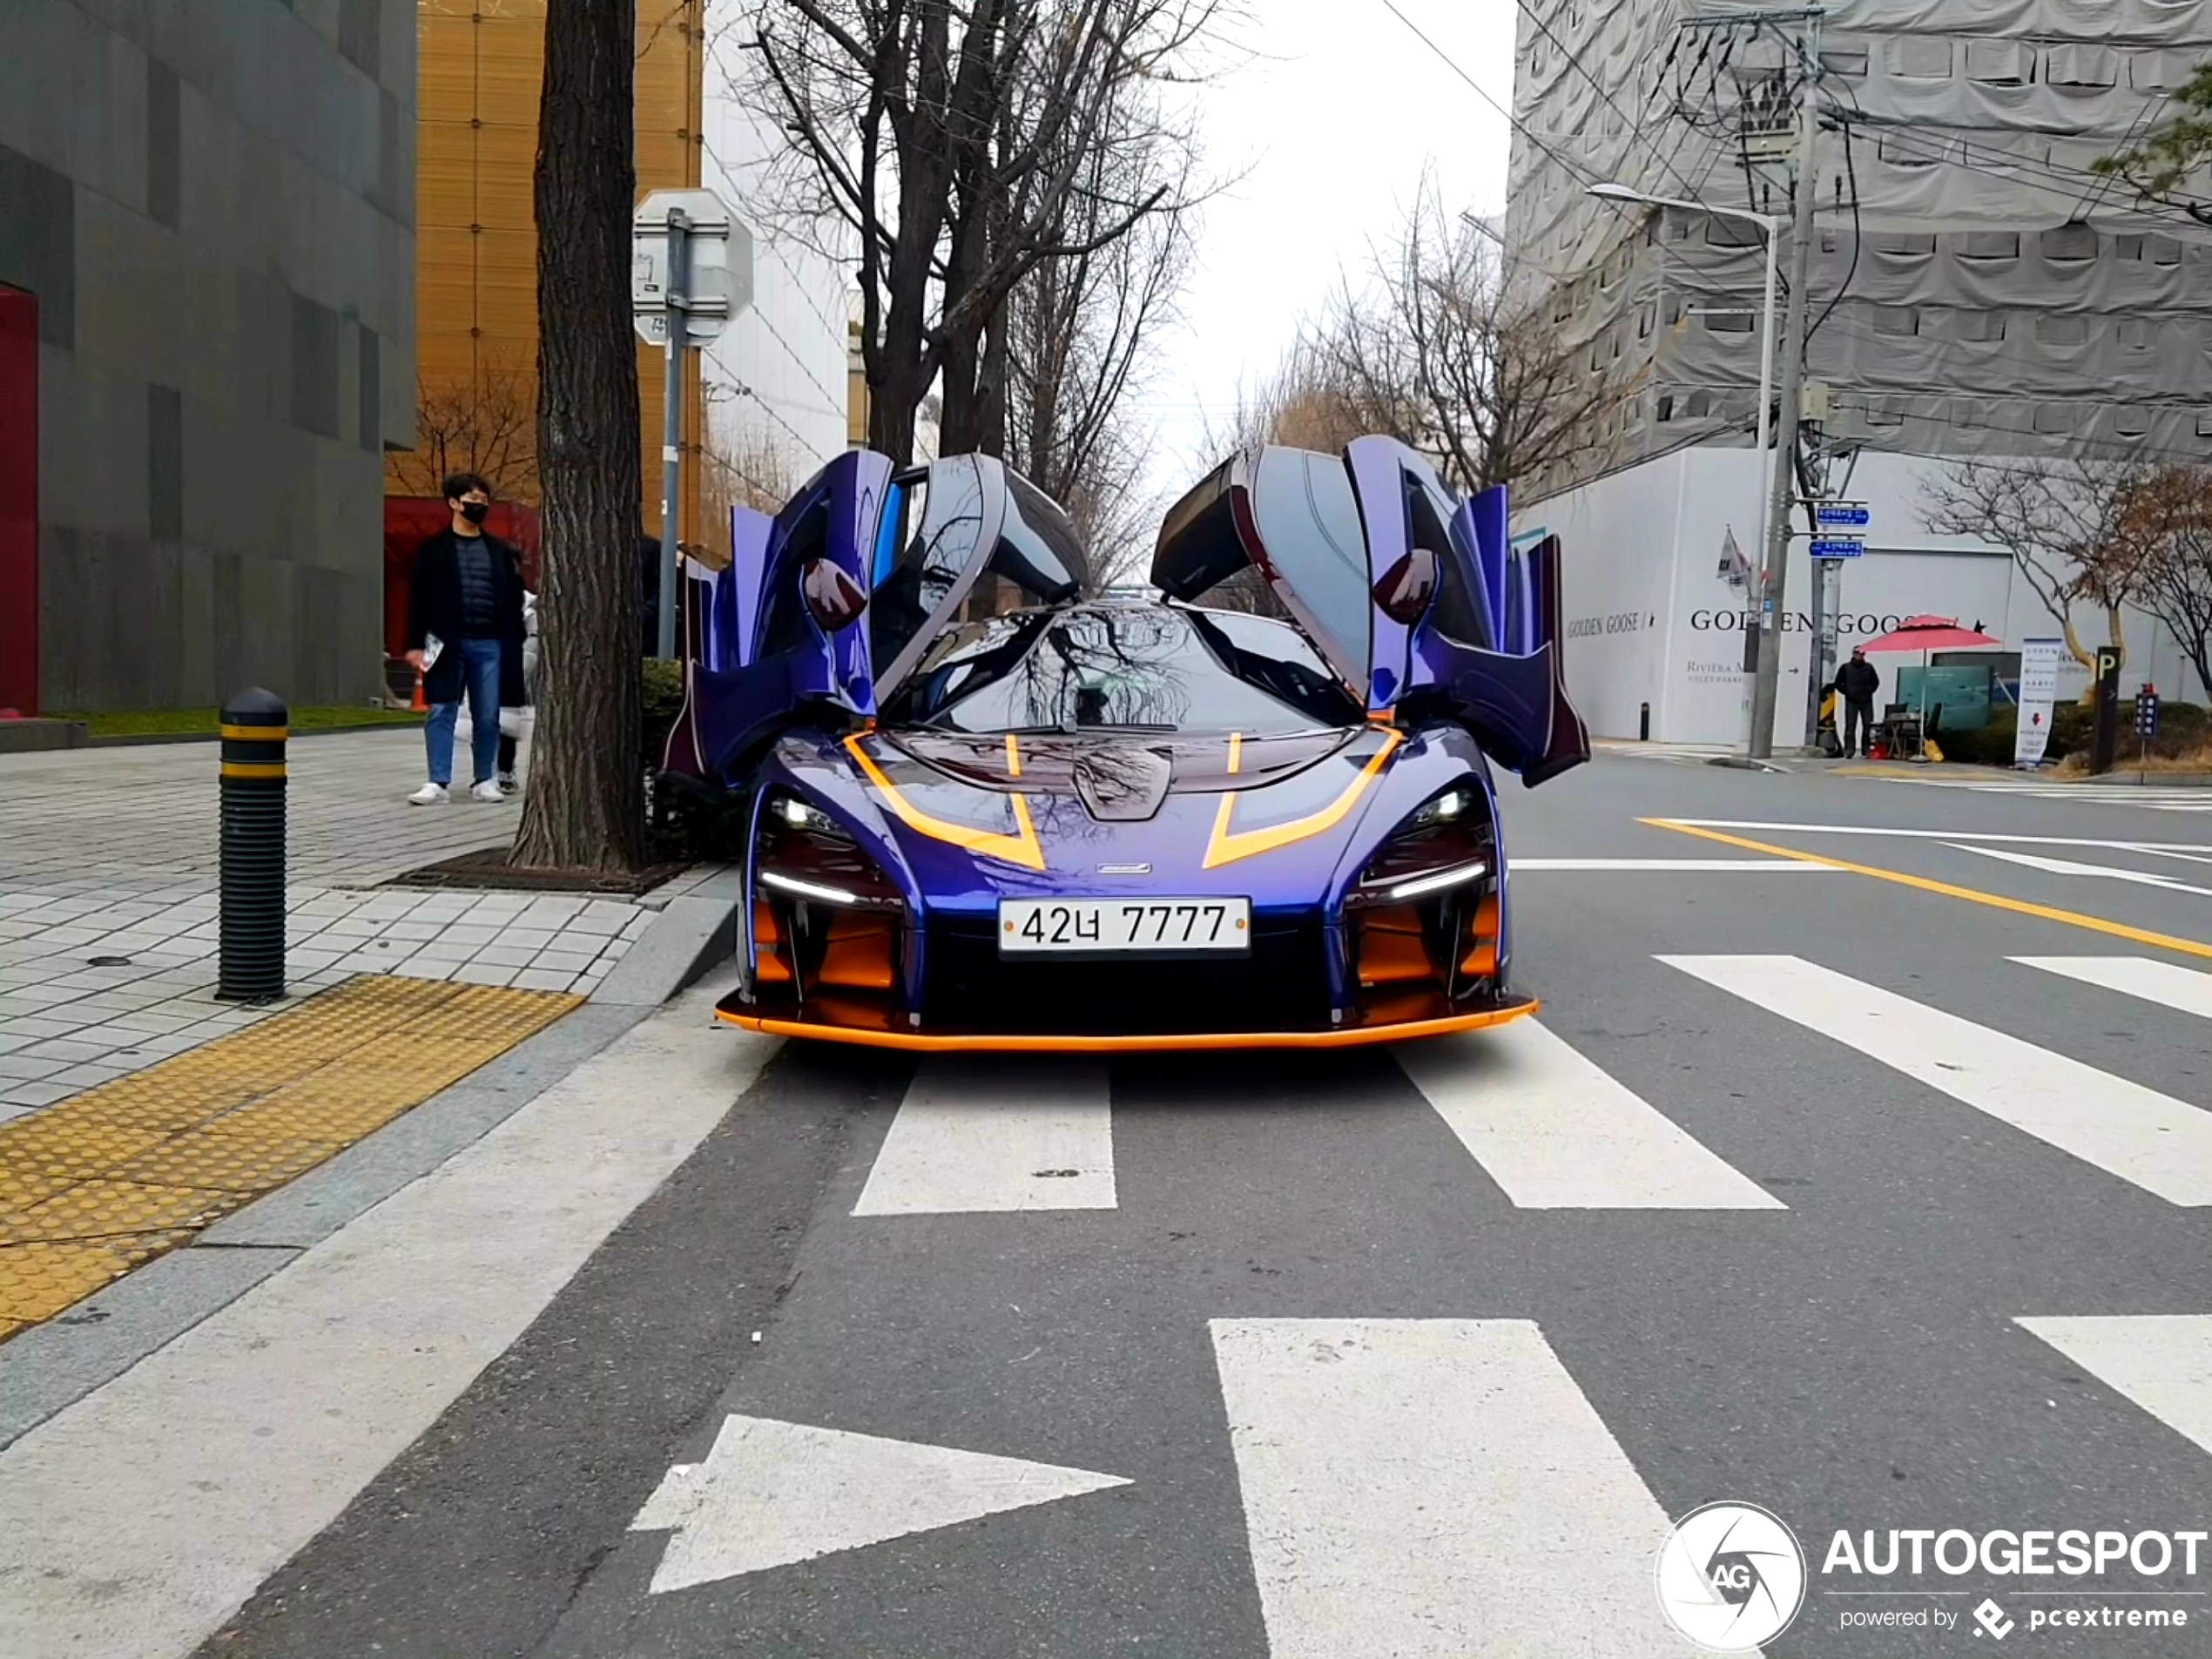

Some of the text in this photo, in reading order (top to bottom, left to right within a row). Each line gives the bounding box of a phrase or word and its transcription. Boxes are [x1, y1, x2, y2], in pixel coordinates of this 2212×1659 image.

[1568, 612, 1638, 638] GOLDEN GOOSE
[1837, 614, 1916, 635] GOO
[2099, 654, 2116, 681] P
[1022, 906, 1226, 943] 42너 7777
